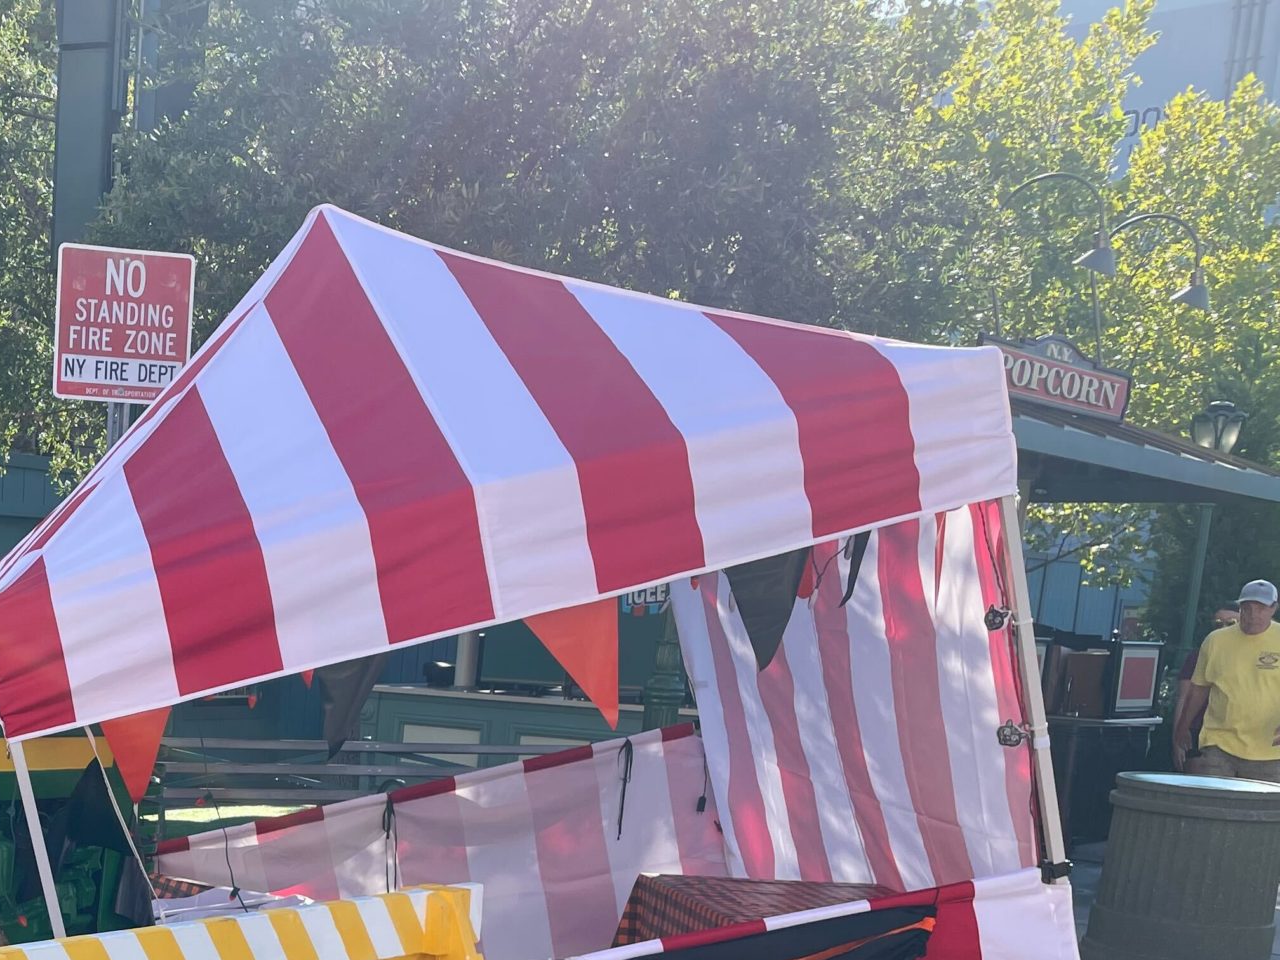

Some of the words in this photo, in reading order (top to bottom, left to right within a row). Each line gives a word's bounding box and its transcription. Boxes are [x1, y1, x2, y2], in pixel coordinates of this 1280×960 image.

[105, 258, 146, 298] NO
[75, 297, 174, 328] STANDING
[69, 325, 113, 352] FIRE
[123, 329, 177, 356] ZONE
[64, 357, 87, 378] NY
[95, 360, 129, 382] FIRE
[138, 362, 177, 384] DEPT
